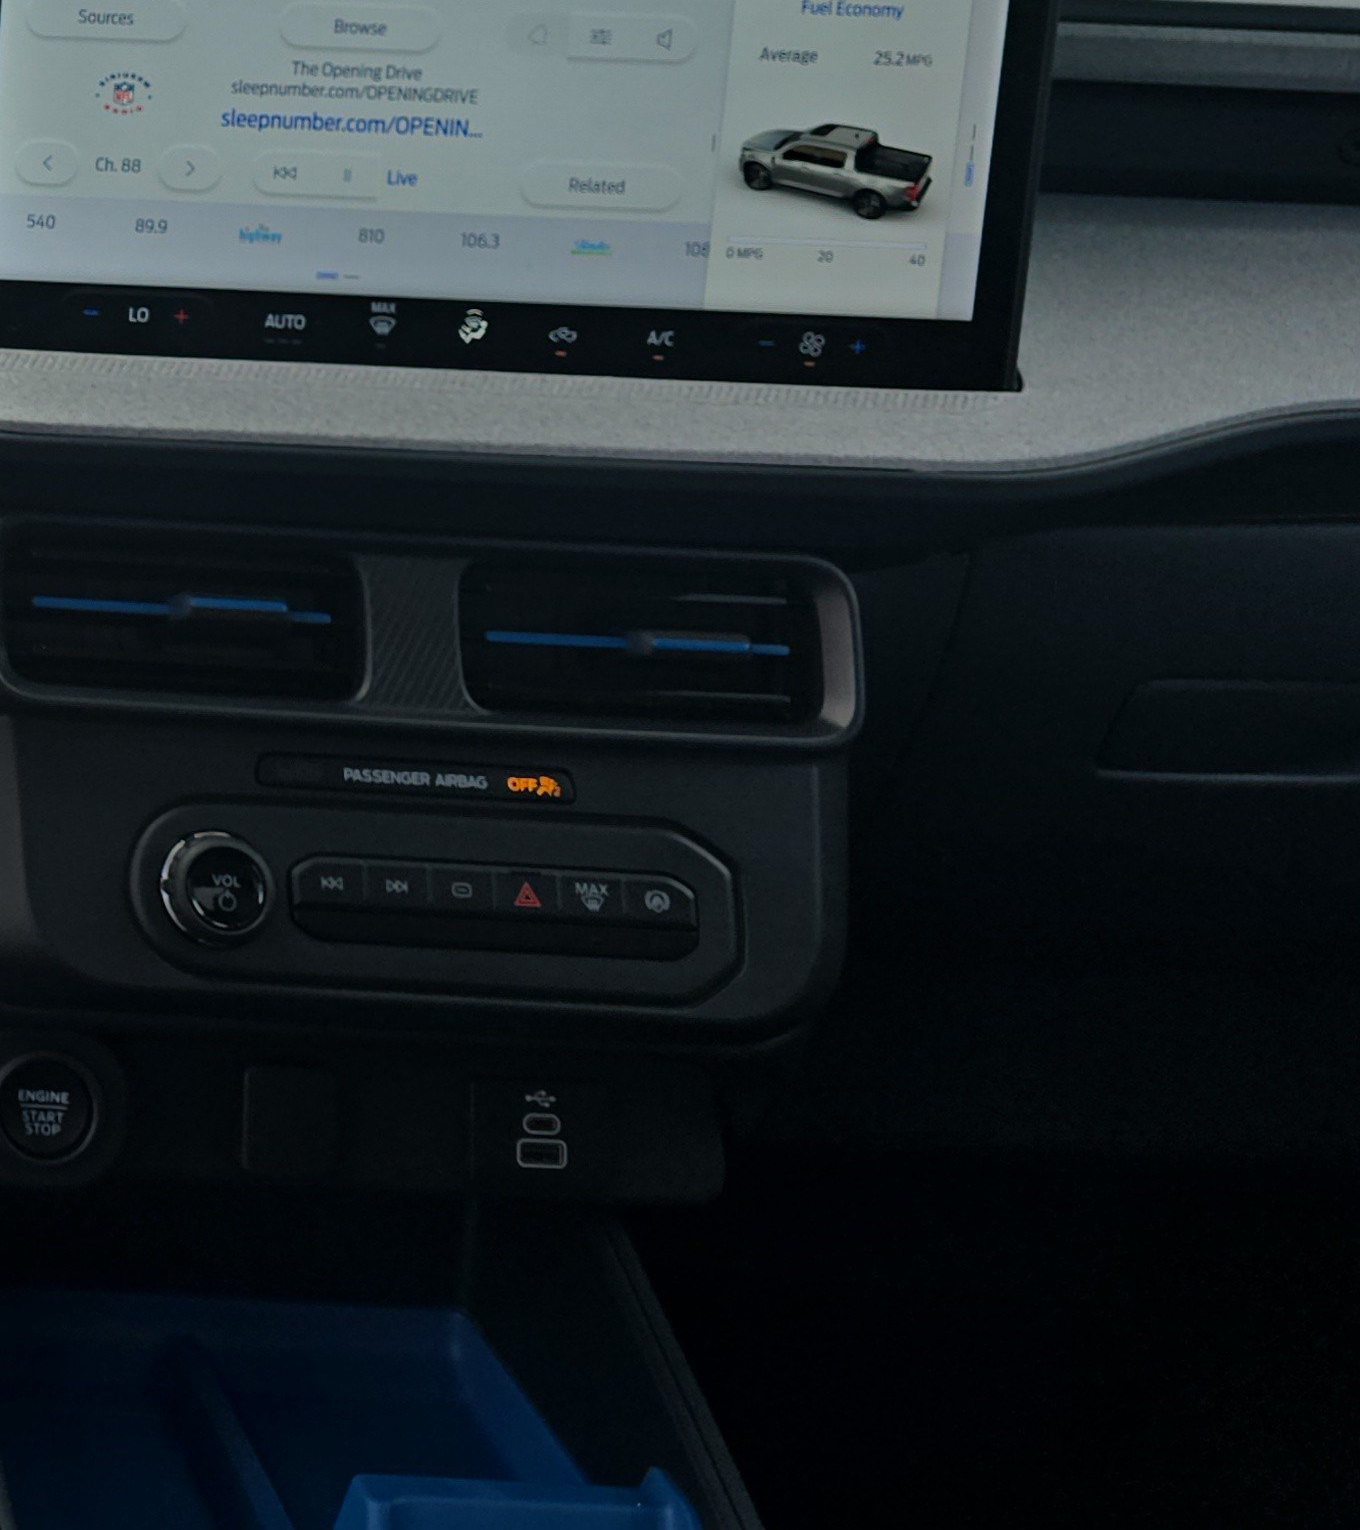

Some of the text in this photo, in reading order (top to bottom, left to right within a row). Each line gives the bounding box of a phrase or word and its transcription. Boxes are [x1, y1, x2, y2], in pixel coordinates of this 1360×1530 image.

[78, 9, 135, 25] Sources
[801, 0, 904, 20] Fuel Economy
[334, 19, 387, 36] Browse
[759, 47, 818, 65] Average
[291, 61, 422, 82] The Opening Drive
[95, 156, 141, 174] Ch. 88
[387, 169, 418, 188] Live
[569, 177, 626, 195] Related
[26, 214, 56, 230] 540
[135, 219, 168, 235] 89.9
[358, 228, 385, 244] 810
[128, 307, 149, 323] LO
[371, 302, 396, 314] MAX
[265, 314, 306, 331] AUTO
[646, 330, 674, 347] A/C
[342, 768, 538, 795] PASSENGER AIRBAG OFF
[211, 874, 242, 889] VOL
[575, 882, 609, 898] MAX
[18, 1089, 70, 1105] ENGINE
[21, 1110, 64, 1124] START
[24, 1121, 62, 1137] STOP
